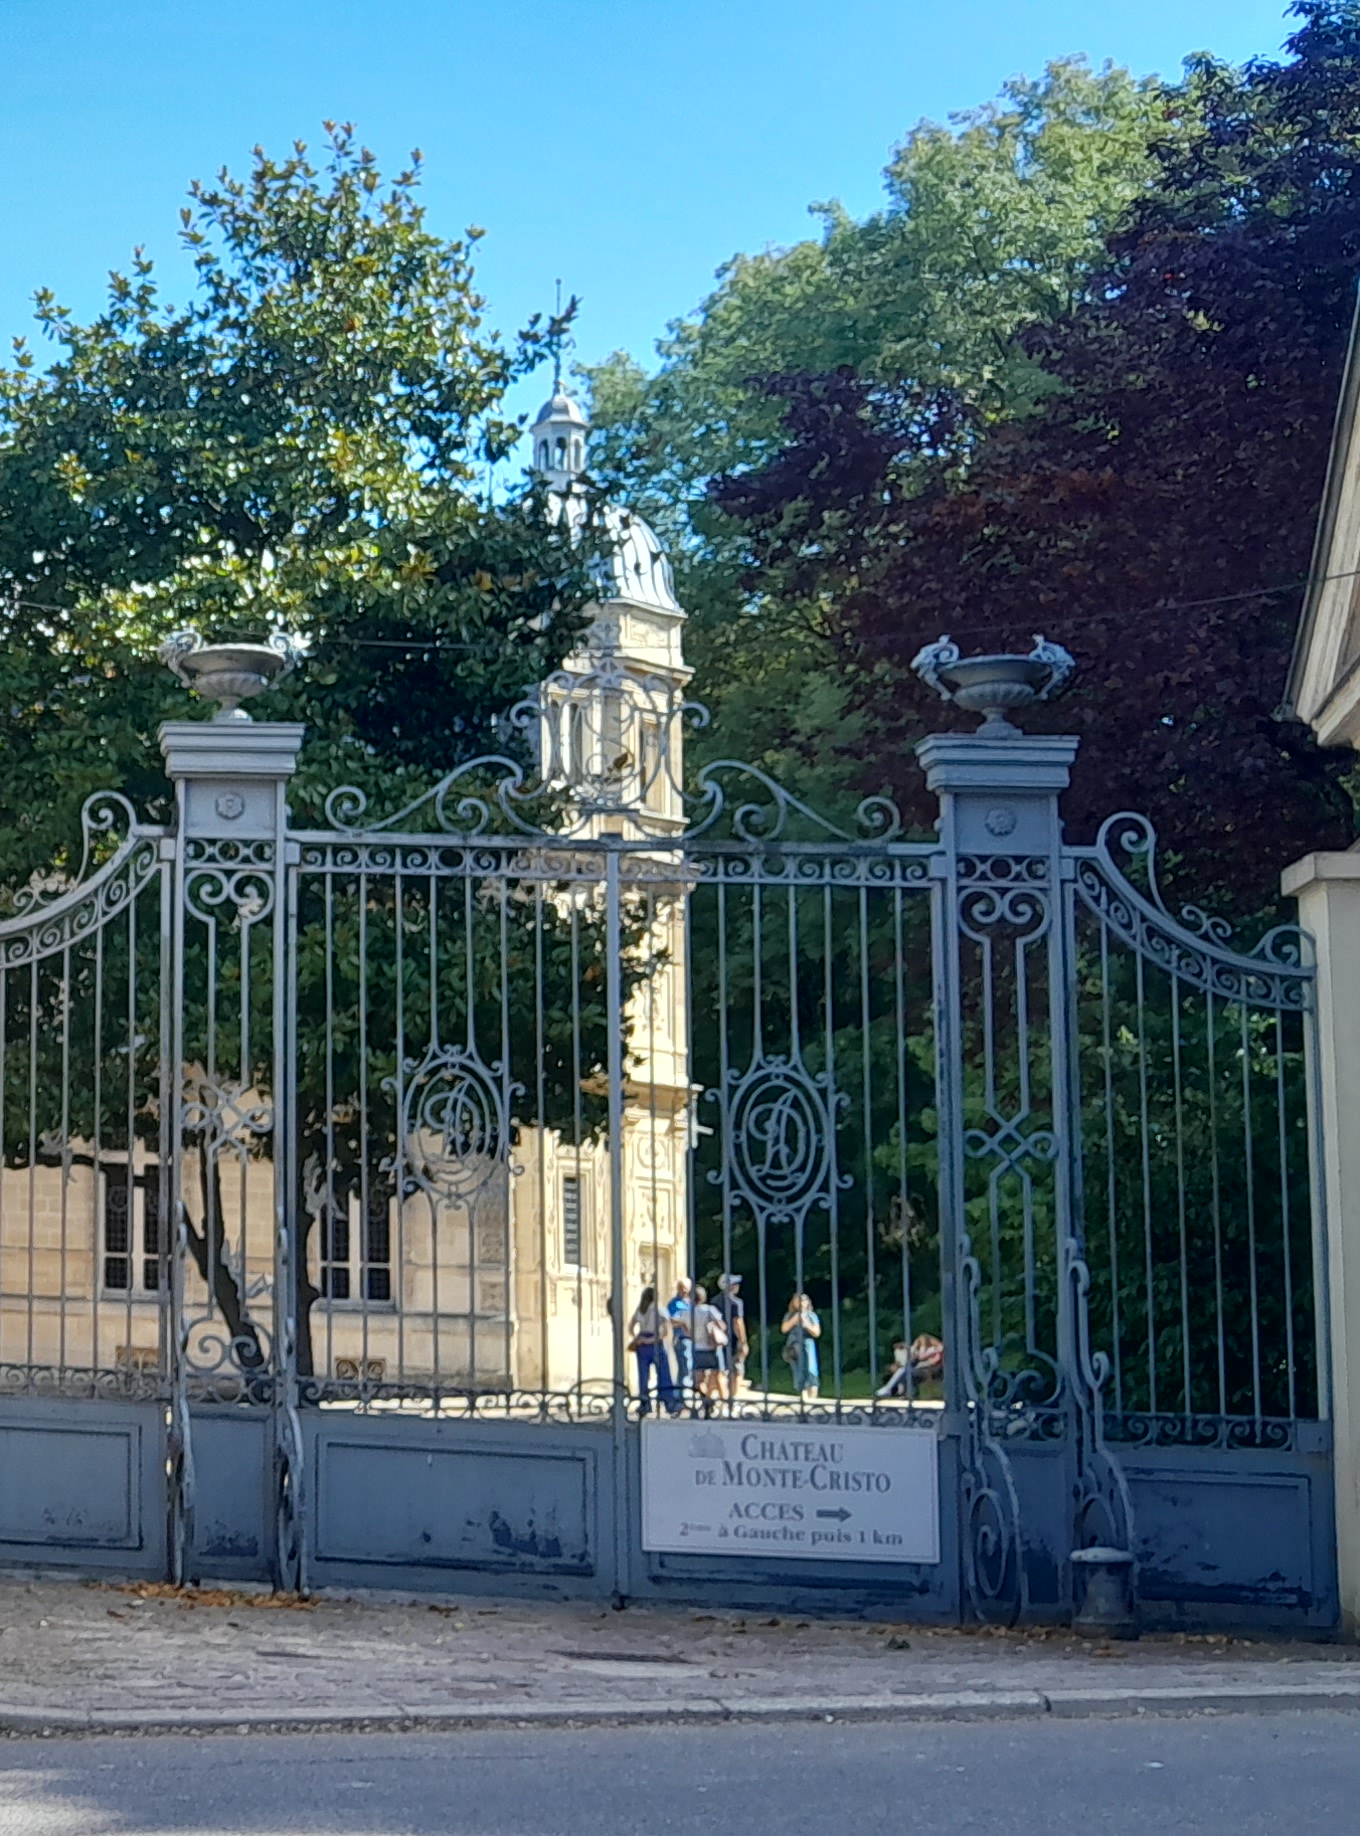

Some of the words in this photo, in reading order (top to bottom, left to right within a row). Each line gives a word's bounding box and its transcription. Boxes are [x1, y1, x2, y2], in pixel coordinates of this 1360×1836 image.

[733, 1524, 806, 1541] Gauche
[811, 1530, 852, 1546] puis
[858, 1530, 866, 1543] 1
[873, 1529, 903, 1545] km
